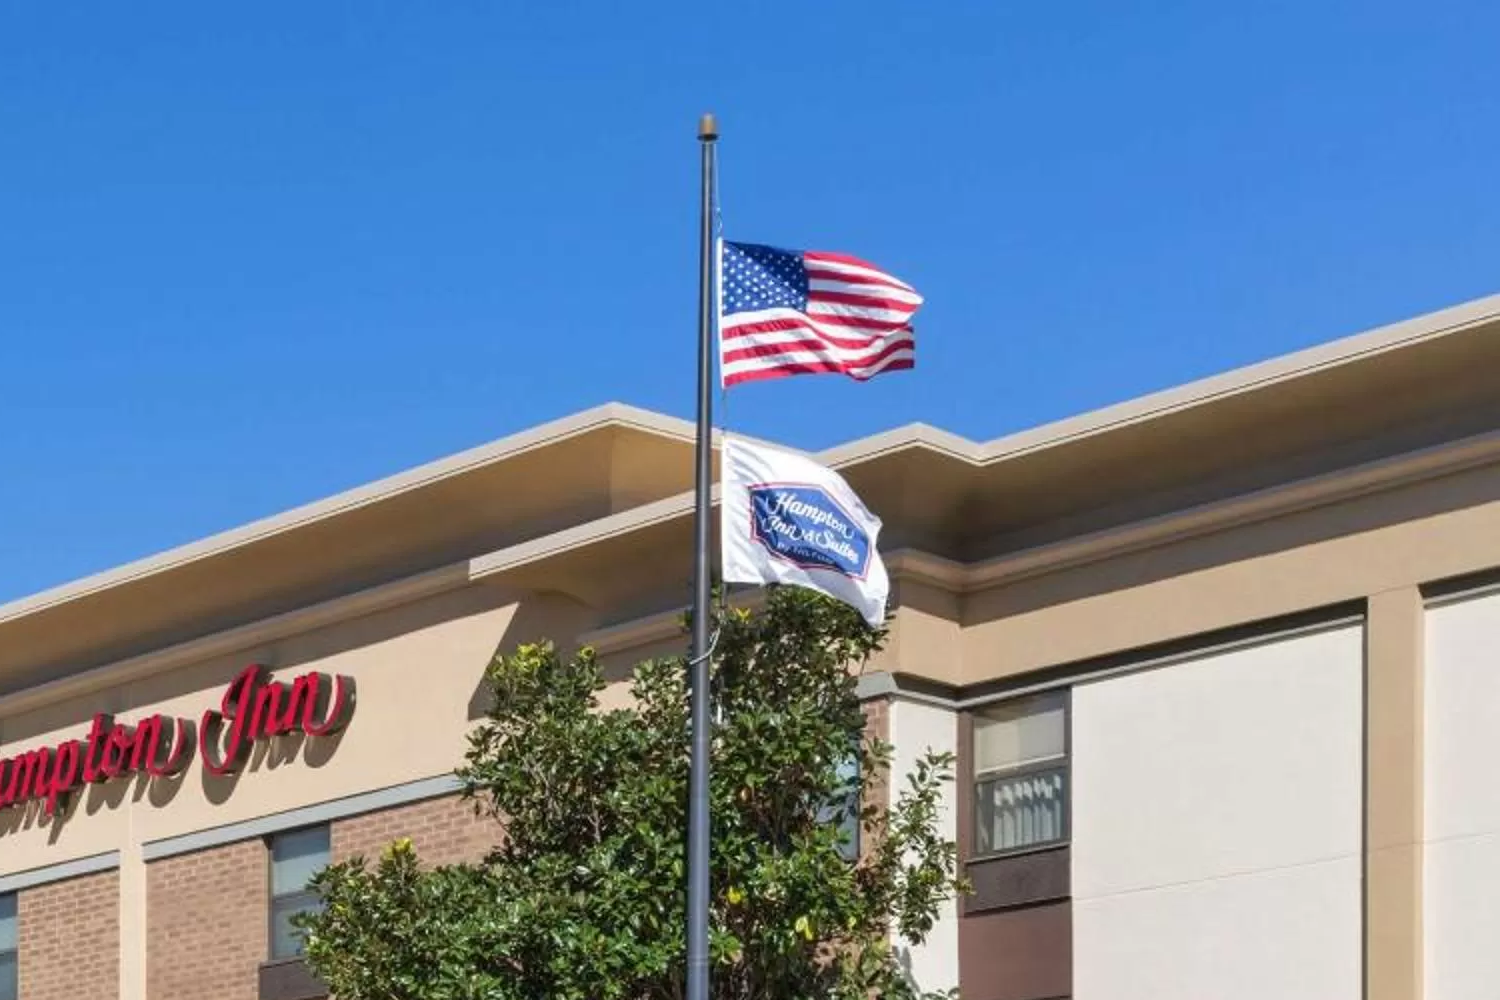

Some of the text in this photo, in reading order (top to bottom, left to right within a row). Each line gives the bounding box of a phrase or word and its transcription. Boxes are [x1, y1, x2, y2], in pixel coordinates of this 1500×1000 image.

[765, 491, 854, 540] Hampton
[763, 516, 803, 541] Inn
[816, 530, 859, 565] Suites
[199, 663, 350, 776] Inn
